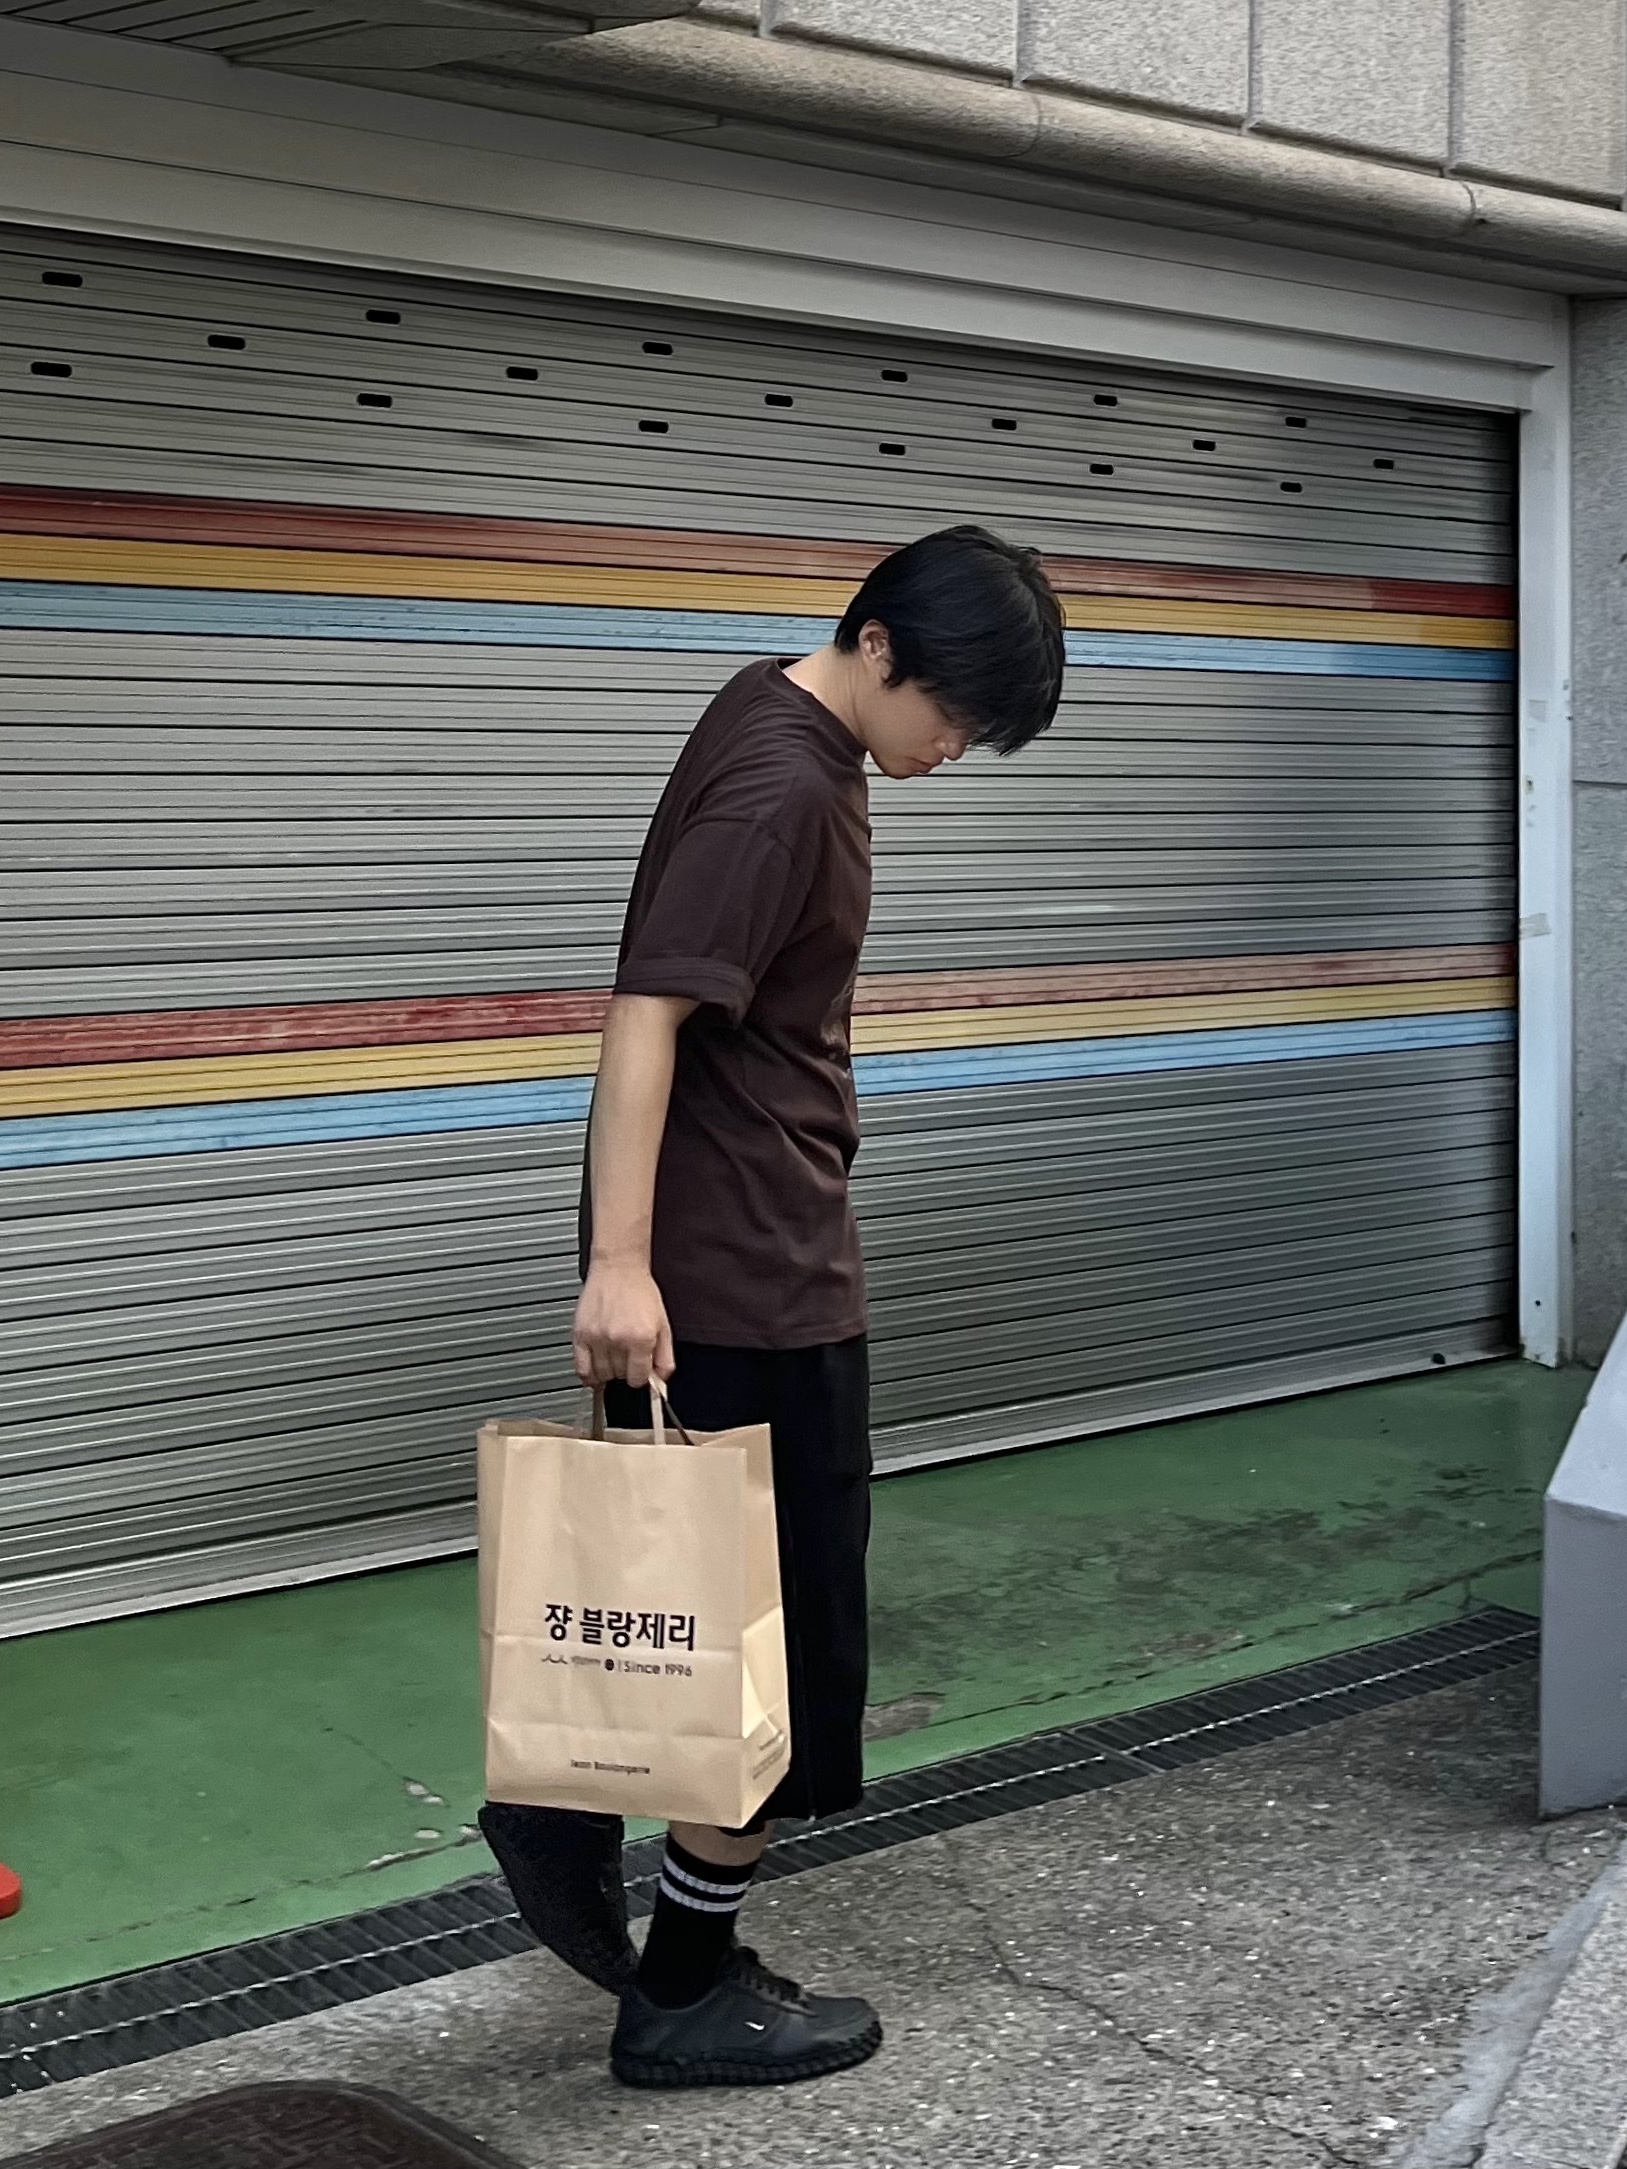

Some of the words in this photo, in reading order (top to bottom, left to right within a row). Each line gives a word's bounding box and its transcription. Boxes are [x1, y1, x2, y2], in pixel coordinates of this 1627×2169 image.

[544, 1604, 573, 1641] 쟝
[580, 1607, 695, 1651] 블랑제리
[624, 1661, 661, 1675] Since
[664, 1663, 693, 1677] 1996
